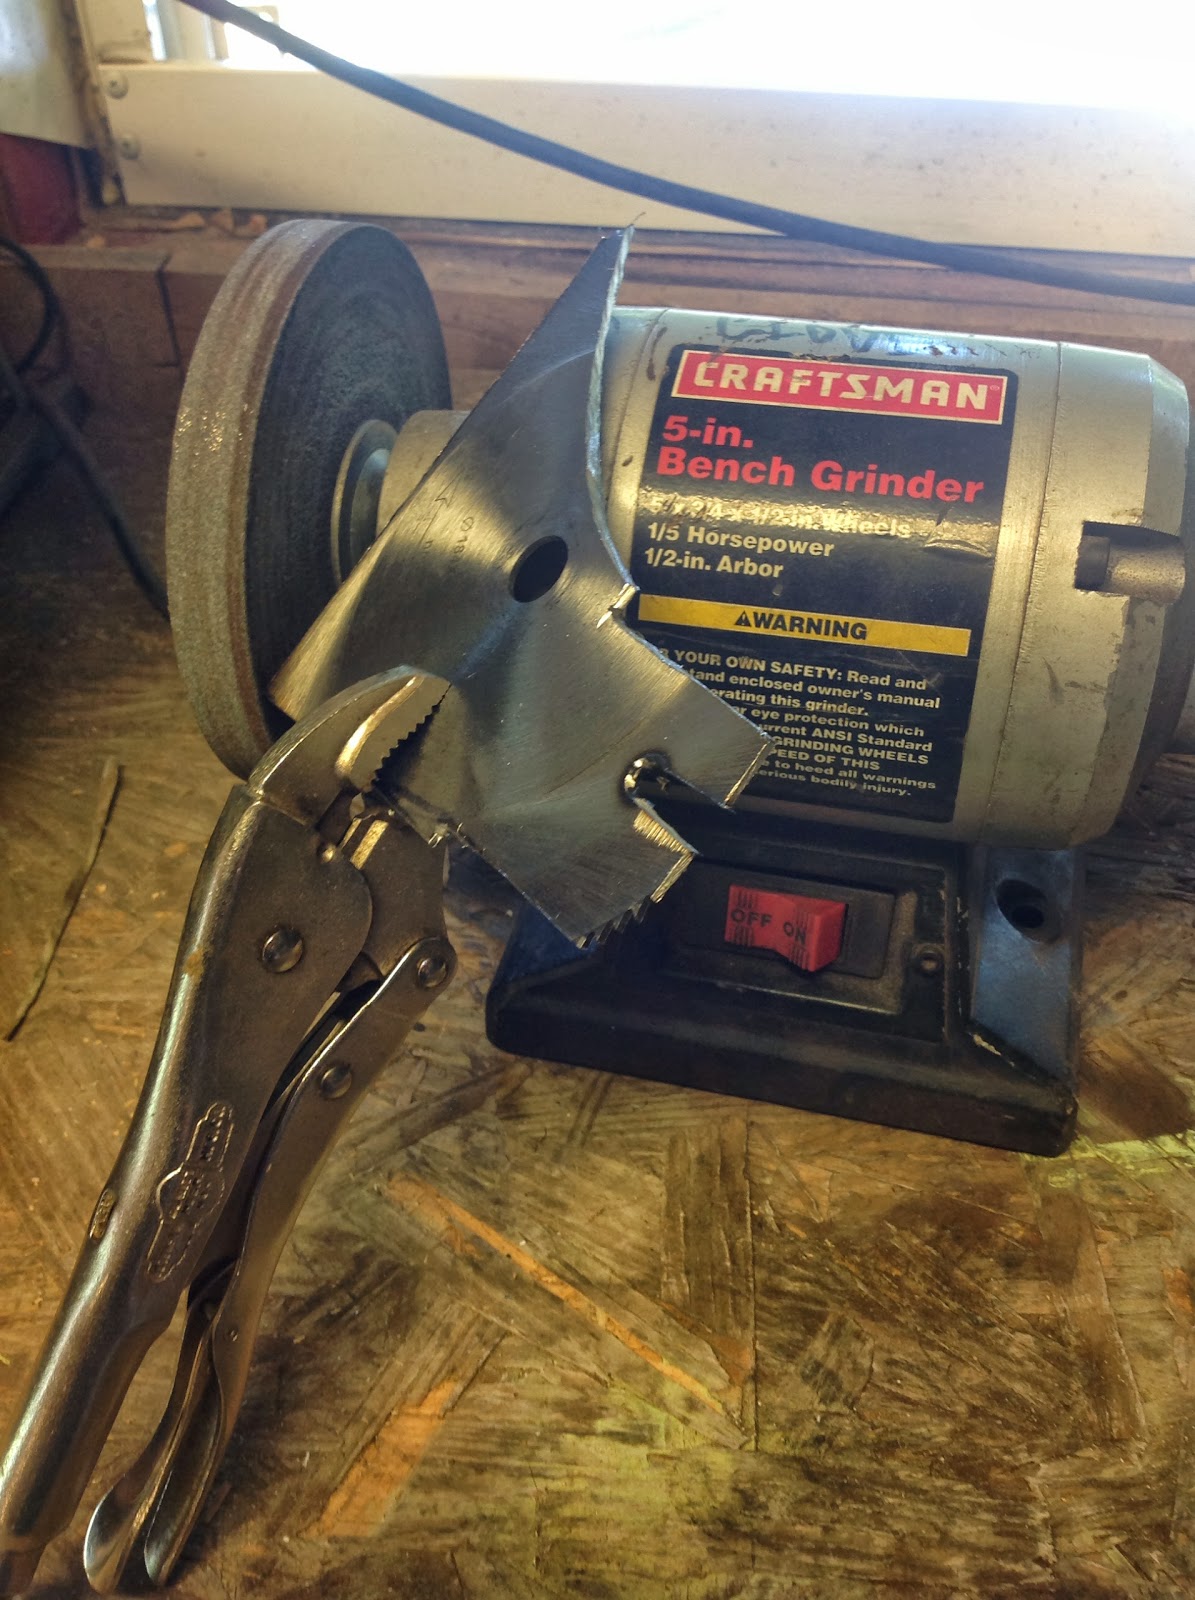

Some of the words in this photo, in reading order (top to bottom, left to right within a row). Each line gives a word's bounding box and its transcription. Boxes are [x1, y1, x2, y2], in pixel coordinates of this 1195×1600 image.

[662, 415, 754, 449] 5-in.
[656, 446, 795, 487] Bench
[811, 460, 984, 503] Grinder
[822, 509, 912, 539] Wheels
[648, 522, 680, 541] 1/5
[687, 525, 835, 557] Horsepower
[645, 547, 711, 571] 1/2-in.
[716, 555, 784, 578] Arbor
[753, 611, 868, 641] WARNING
[674, 649, 722, 666] YOUR
[725, 656, 767, 671] OWN
[770, 661, 842, 680] SAFETY:
[847, 670, 891, 686] Read
[894, 678, 928, 690] and
[710, 688, 766, 705] erating
[770, 694, 801, 708] this
[805, 700, 869, 716] grinder.
[729, 675, 804, 692] enclosed
[807, 685, 872, 701] owner's
[877, 692, 941, 709] manual
[750, 708, 780, 720] eye
[784, 712, 869, 730] protection
[875, 722, 925, 737] which
[773, 735, 854, 755] GRINDING
[858, 746, 929, 765] WHEELS
[812, 727, 852, 742] ANSI
[857, 733, 933, 752] Standard
[774, 760, 791, 770] to
[795, 762, 834, 775] heed
[838, 769, 858, 779] all
[862, 772, 936, 789] warnings
[813, 754, 836, 764] OF
[841, 757, 880, 771] THIS
[811, 775, 858, 790] bodily
[862, 782, 912, 797] injury.
[731, 909, 773, 927] OFF
[783, 921, 806, 945] ON
